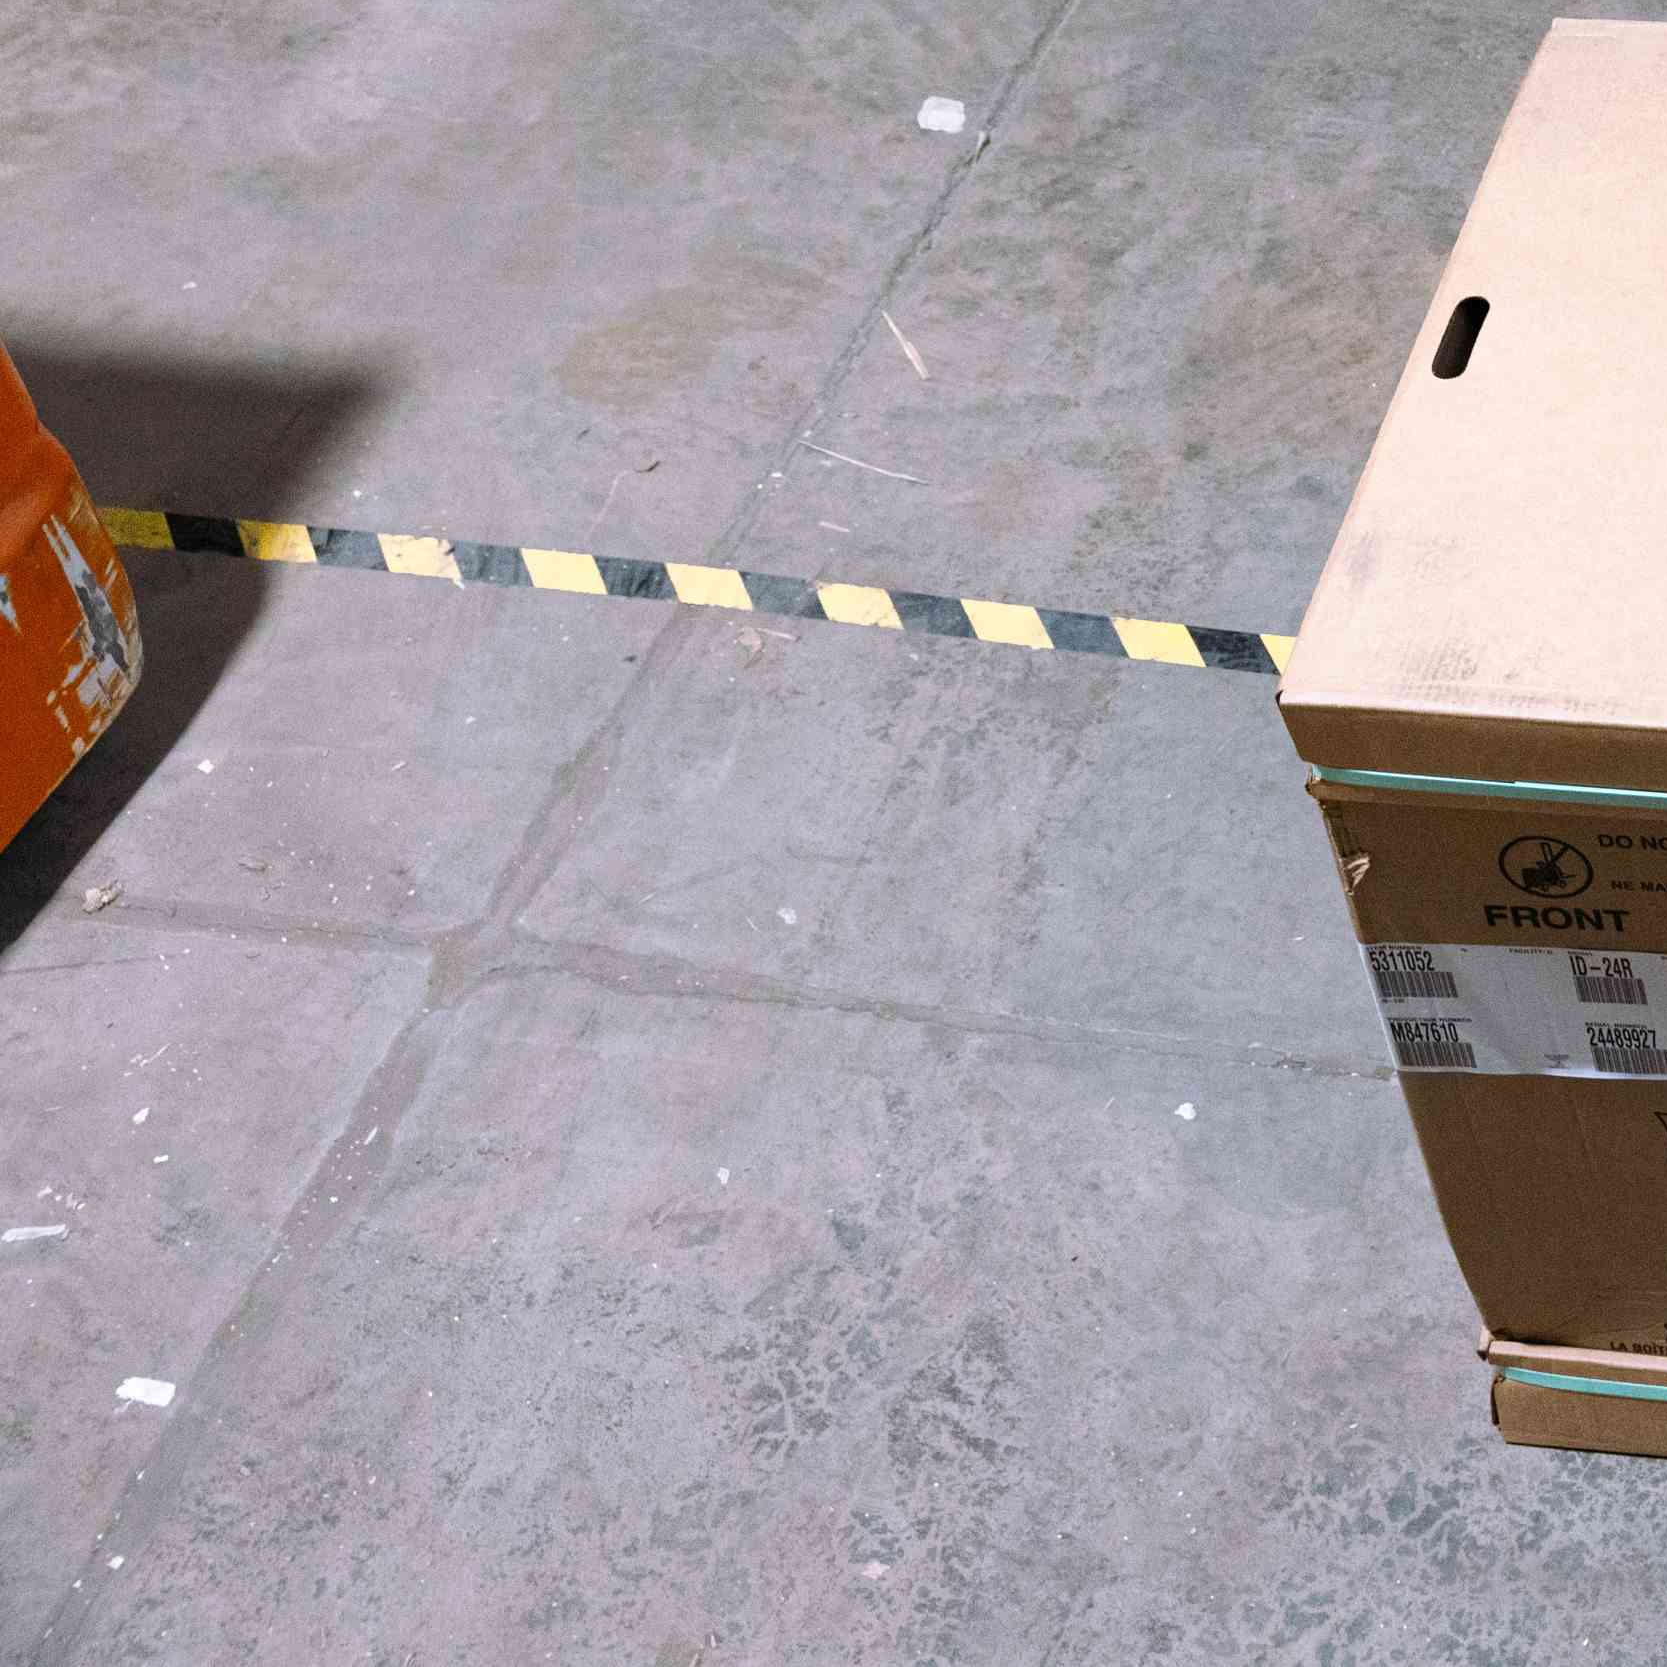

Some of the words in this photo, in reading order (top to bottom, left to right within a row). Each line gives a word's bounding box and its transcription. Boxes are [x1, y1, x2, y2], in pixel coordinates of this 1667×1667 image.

[1597, 833, 1634, 850] DO
[1610, 879, 1635, 891] NE
[1483, 904, 1631, 933] FRONT
[1369, 950, 1436, 972] 5311052
[1389, 1021, 1460, 1043] M847610
[1586, 1026, 1657, 1050] 24489927
[1609, 1340, 1628, 1353] LA
